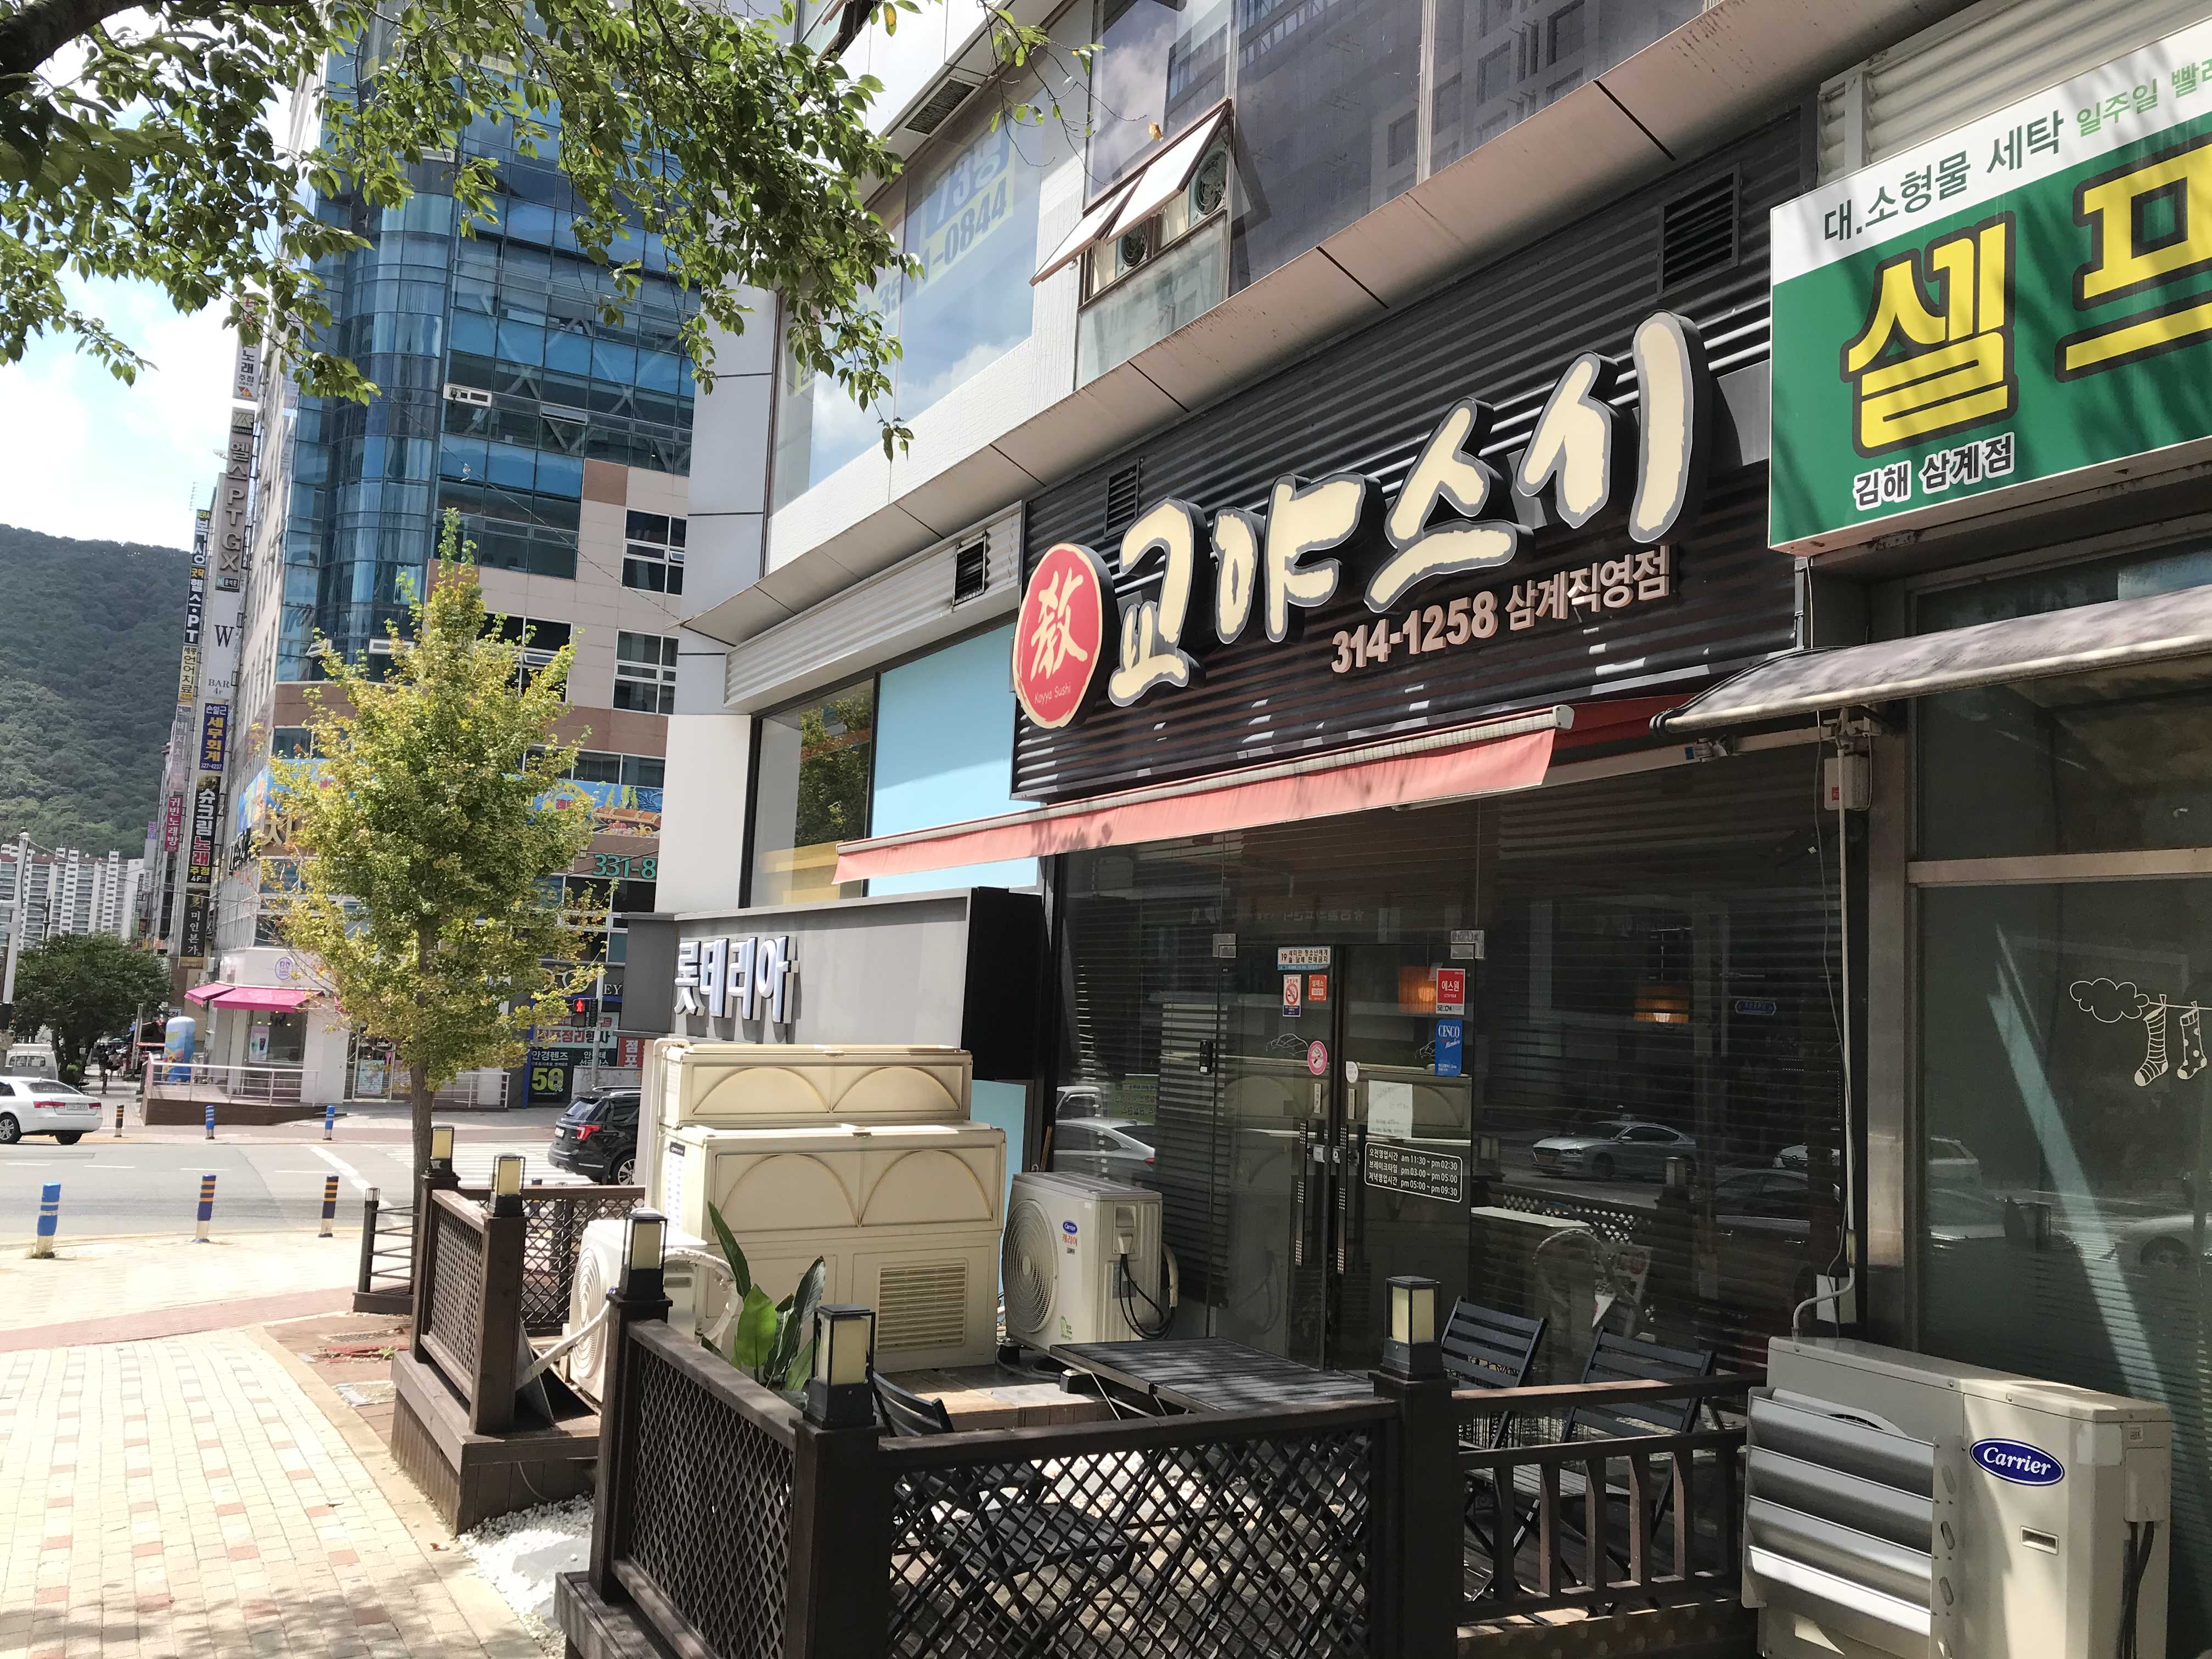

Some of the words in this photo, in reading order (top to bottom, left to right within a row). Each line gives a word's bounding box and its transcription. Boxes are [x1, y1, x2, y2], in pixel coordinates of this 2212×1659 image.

[1986, 109, 2064, 174] 세탁
[2076, 78, 2158, 138] 일주일
[227, 442, 250, 481] 헬스
[1856, 461, 1910, 508] 김해
[1920, 433, 2013, 492] 삼계점
[225, 487, 245, 527] PT
[1108, 310, 1696, 707] 교야스시
[193, 518, 208, 565] 복싱
[219, 532, 241, 572] GX
[1331, 591, 1498, 674] 314-1258
[1505, 545, 1671, 631] 삼계직영점
[214, 624, 235, 648] W
[181, 655, 196, 694] 언어치료
[208, 679, 230, 689] BAR
[1054, 680, 1071, 698] Sushi
[204, 716, 224, 762] 세무회계
[167, 797, 180, 846] 귀빈노래방
[190, 866, 210, 876] 주점
[187, 911, 201, 956] 미인본가
[674, 936, 794, 1024] 롯데리아
[1441, 980, 1459, 992] 에스원
[1438, 1024, 1460, 1038] CESCO
[532, 1051, 569, 1061] 안경렌즈
[583, 1051, 606, 1059] 안테
[1369, 1148, 1398, 1161] 오전영업시간
[1410, 1155, 1426, 1165] 11:30
[1431, 1160, 1440, 1169] pm
[1441, 1160, 1458, 1171] 02:30
[1369, 1160, 1398, 1174] 브레이크타임
[1401, 1167, 1409, 1176] pm
[1431, 1173, 1440, 1182] pm
[1441, 1173, 1458, 1183] 05:00
[1368, 1172, 1398, 1186] 저녁영업시간
[1401, 1180, 1409, 1188] pm
[1410, 1180, 1426, 1190] 05:00
[1431, 1186, 1440, 1194] pm
[1441, 1186, 1458, 1197] 09:30
[1983, 1446, 2051, 1476] Carrier
